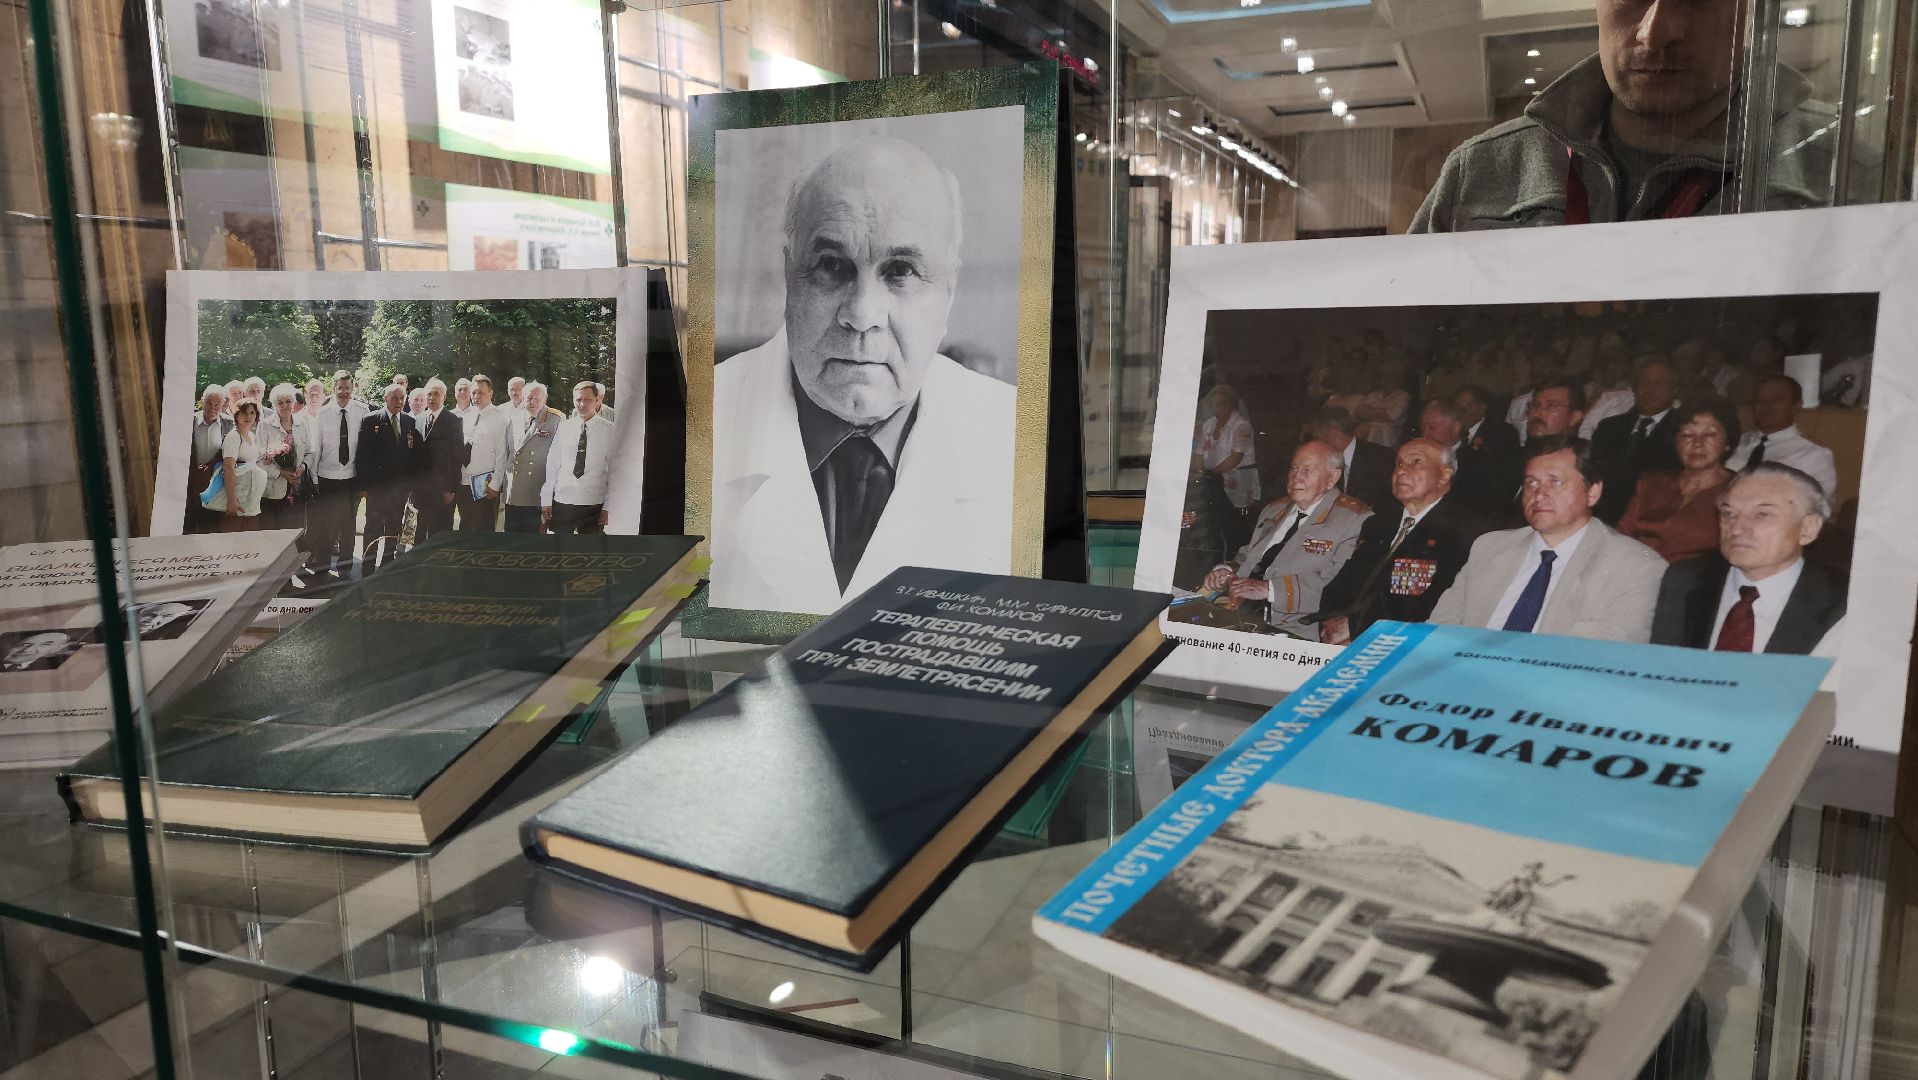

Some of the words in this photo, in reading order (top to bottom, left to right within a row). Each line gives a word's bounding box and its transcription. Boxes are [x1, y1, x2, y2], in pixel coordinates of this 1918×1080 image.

[167, 552, 260, 564] МЕДИКИ
[422, 551, 648, 569] РУКОВОДСТВО
[870, 609, 1082, 650] ТЕРАПЕВТИЧЕСКАЯ
[966, 605, 1044, 622] КОМАРОВ
[841, 637, 1039, 679] ПОСТРАДАВШИМ
[900, 630, 1005, 656] ПОМОЩЬ
[1227, 642, 1279, 660] 40-летия
[1282, 652, 1296, 662] со
[1298, 655, 1321, 667] дня
[796, 648, 849, 668] ПРИ
[846, 657, 1052, 702] ЗЕМЛЕТРЯСЕНИИ
[1641, 672, 1740, 688] АКАДЕМИЯ
[1377, 692, 1495, 721] Федор
[1507, 707, 1736, 755] Иванович
[1349, 714, 1708, 790] КОМАРОВ
[1062, 799, 1217, 924] ПОЧЕТНЫЕ
[1203, 720, 1311, 801] ДОКТОРА
[1293, 633, 1409, 719] АКАДЕМИИ
